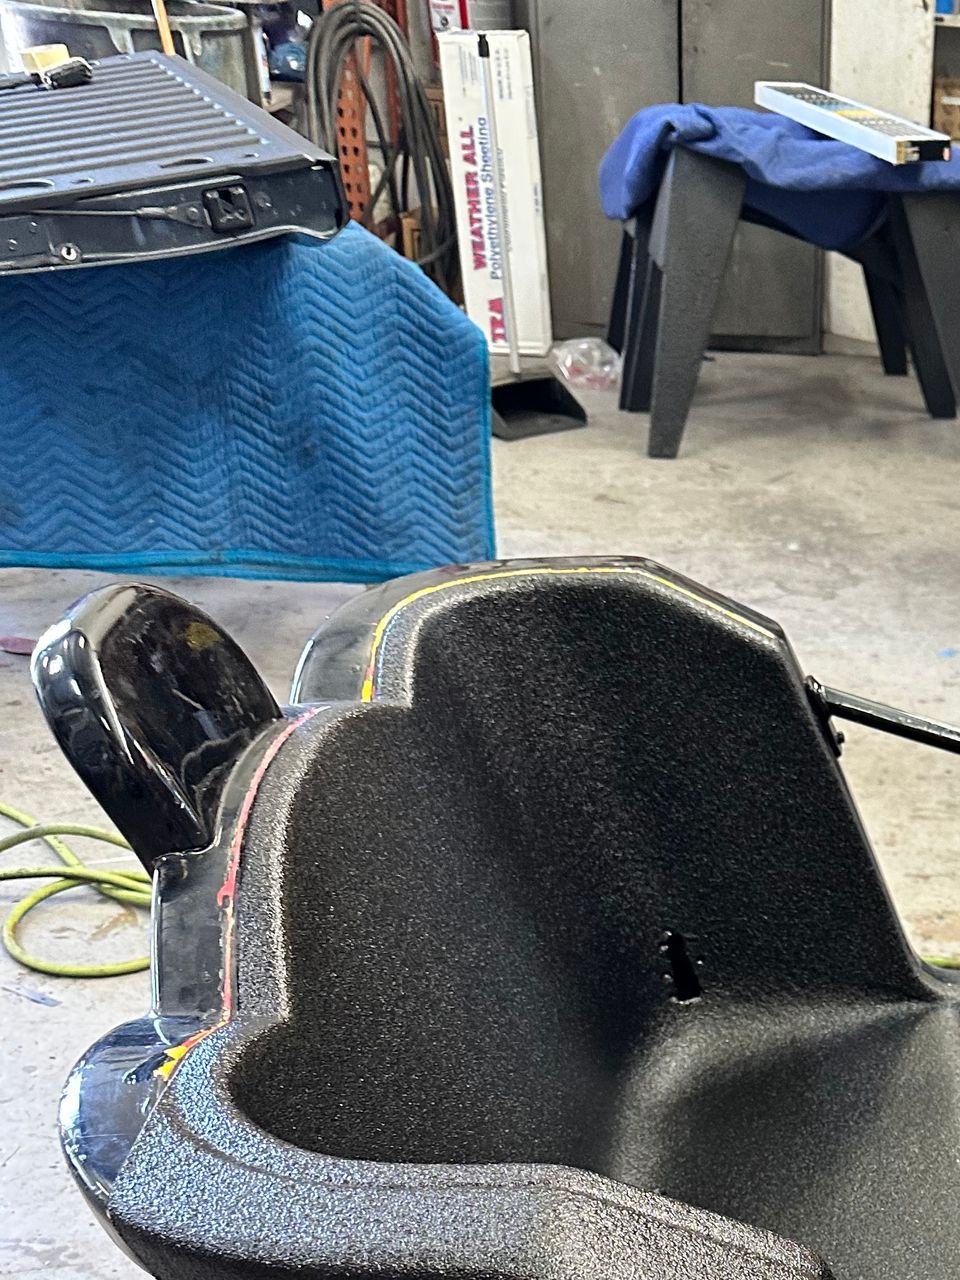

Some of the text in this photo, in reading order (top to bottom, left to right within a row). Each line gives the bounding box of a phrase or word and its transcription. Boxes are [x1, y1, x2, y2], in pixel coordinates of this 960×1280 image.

[460, 125, 488, 270] WEATHER ALL
[477, 117, 501, 280] Polyethylene Sheeting
